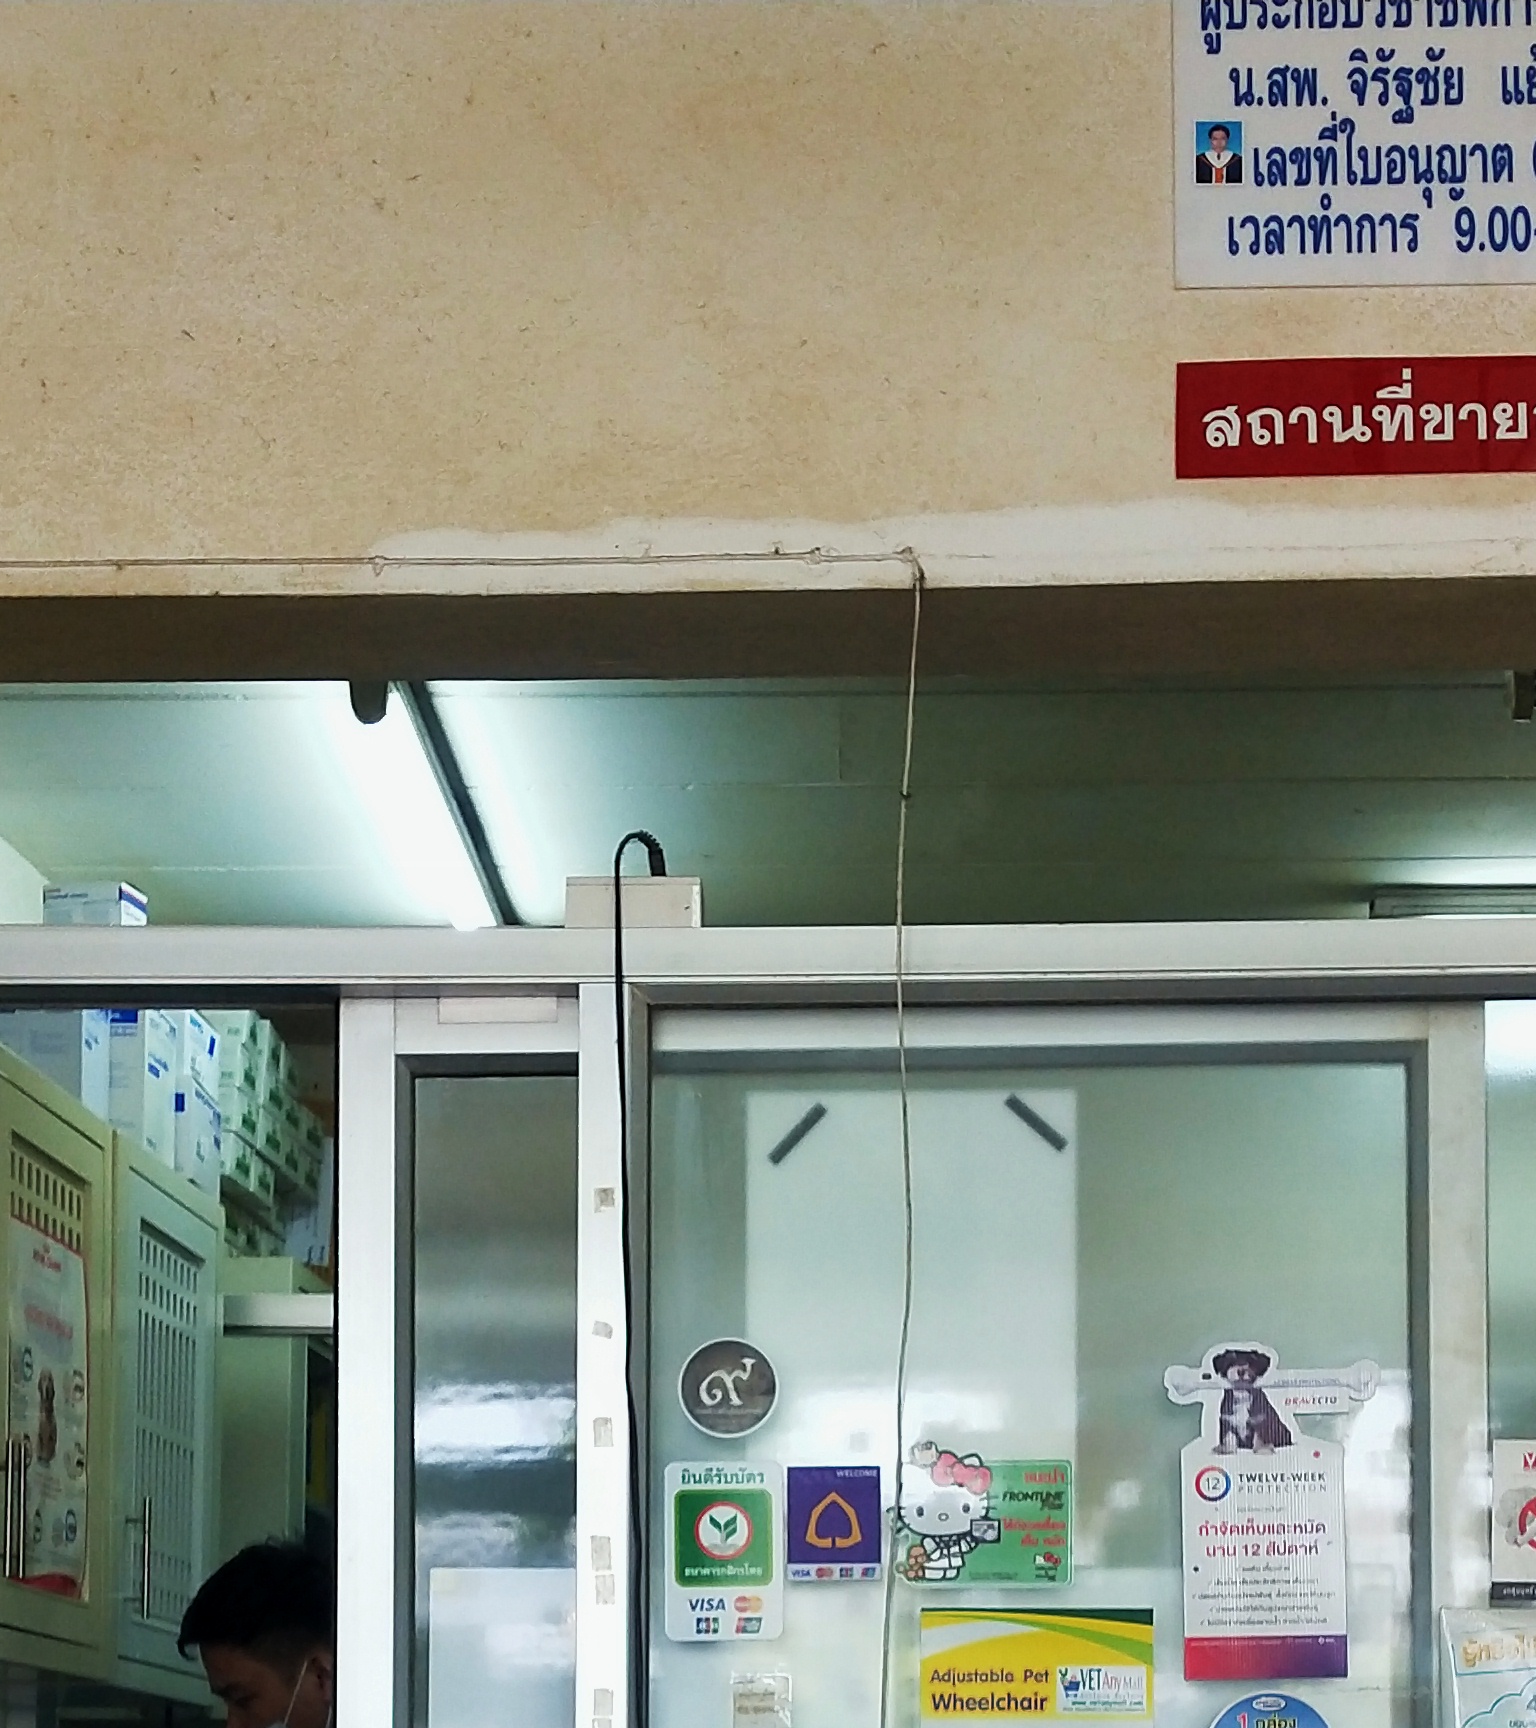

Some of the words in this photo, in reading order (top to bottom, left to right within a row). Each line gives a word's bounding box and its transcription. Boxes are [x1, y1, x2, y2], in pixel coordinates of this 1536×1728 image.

[1229, 66, 1329, 107] น.สพ.
[1347, 47, 1464, 124] จิรัฐชัย
[1252, 113, 1514, 209] เลขที่ใบอนุญาต
[1227, 195, 1420, 258] เวลาทำการ
[681, 1467, 765, 1485] ยินดีรับบัตร
[835, 1469, 878, 1478] WELCOME
[1205, 1477, 1221, 1491] 12
[1238, 1473, 1326, 1483] TWELVE-WEEK
[1238, 1485, 1327, 1493] PROTECTION
[1205, 1544, 1237, 1558] นาน
[1241, 1542, 1261, 1557] 12
[1265, 1540, 1319, 1557] สัปดาห์
[687, 1598, 727, 1613] VISA
[929, 1667, 1014, 1687] Adjustable
[1023, 1669, 1050, 1684] Pet
[931, 1692, 1049, 1712] Wheelchair
